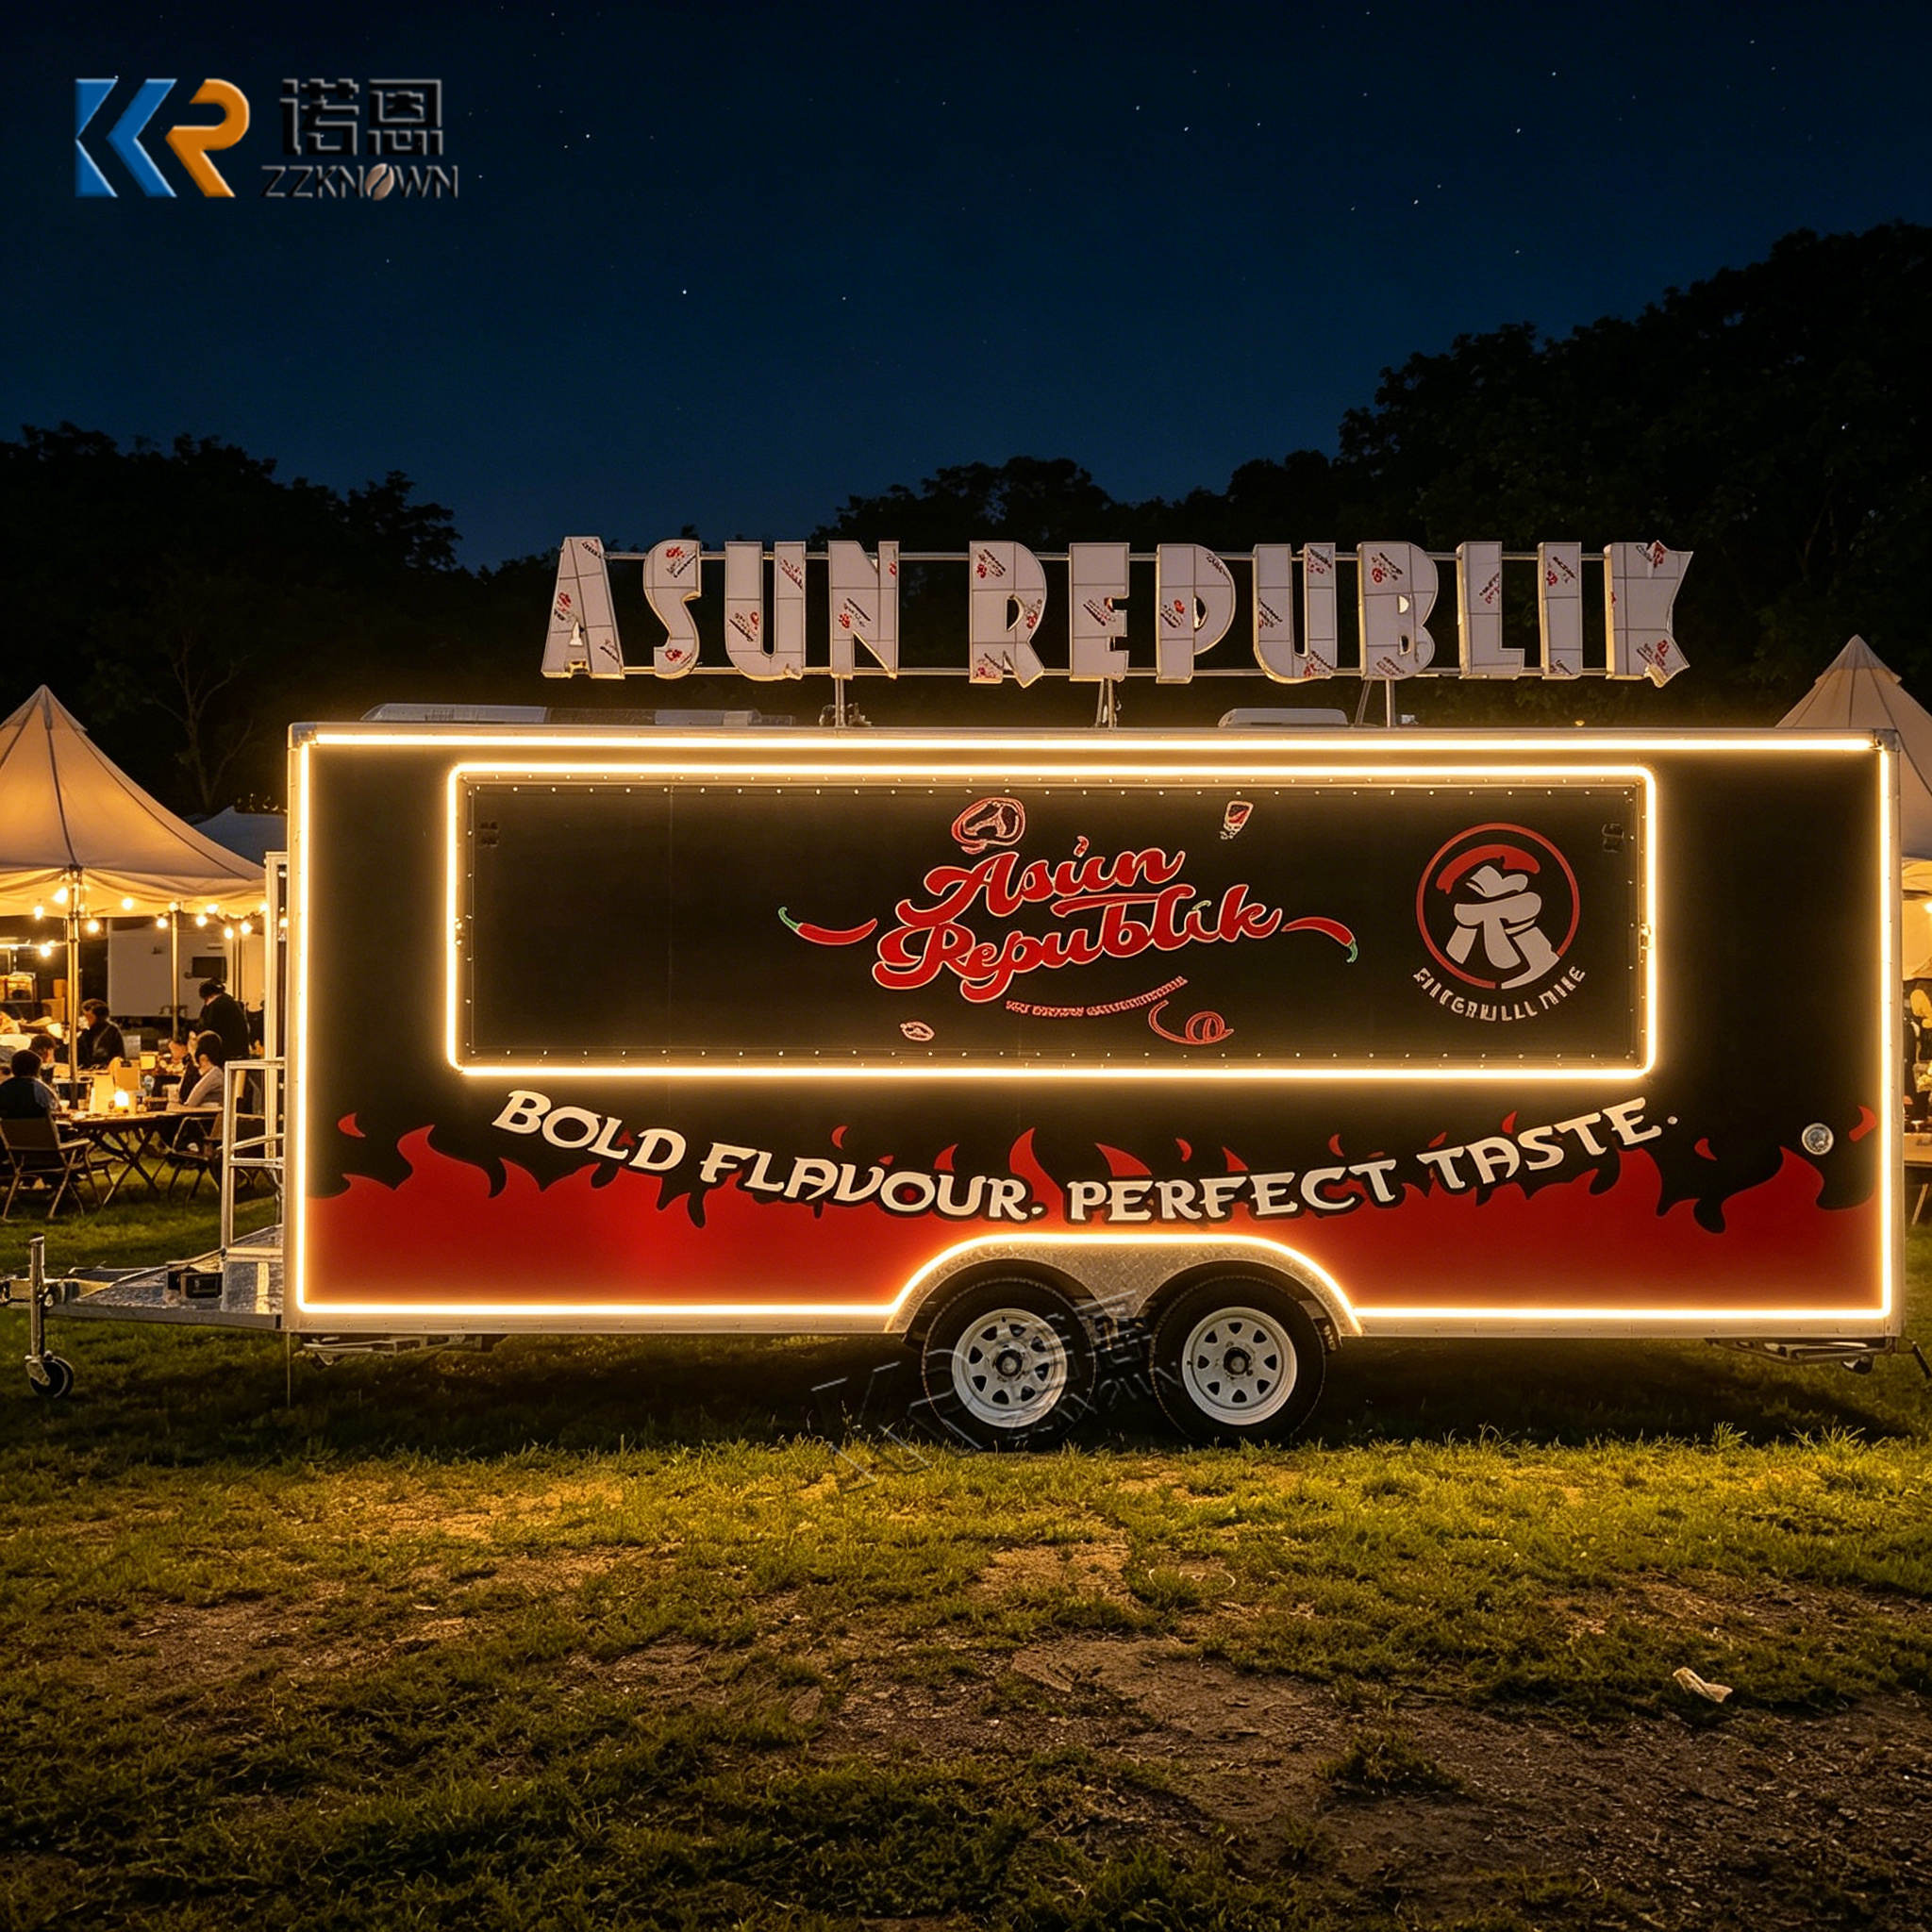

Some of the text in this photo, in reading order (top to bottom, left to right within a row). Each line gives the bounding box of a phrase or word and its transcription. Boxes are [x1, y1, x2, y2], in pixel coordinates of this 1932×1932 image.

[541, 536, 1693, 689] ASUN REPUBLIK
[872, 883, 1283, 1003] Republik
[491, 1090, 687, 1172] BOLD
[699, 1141, 1043, 1221] FLAVOUR.
[1067, 1158, 1396, 1222] PERFECT
